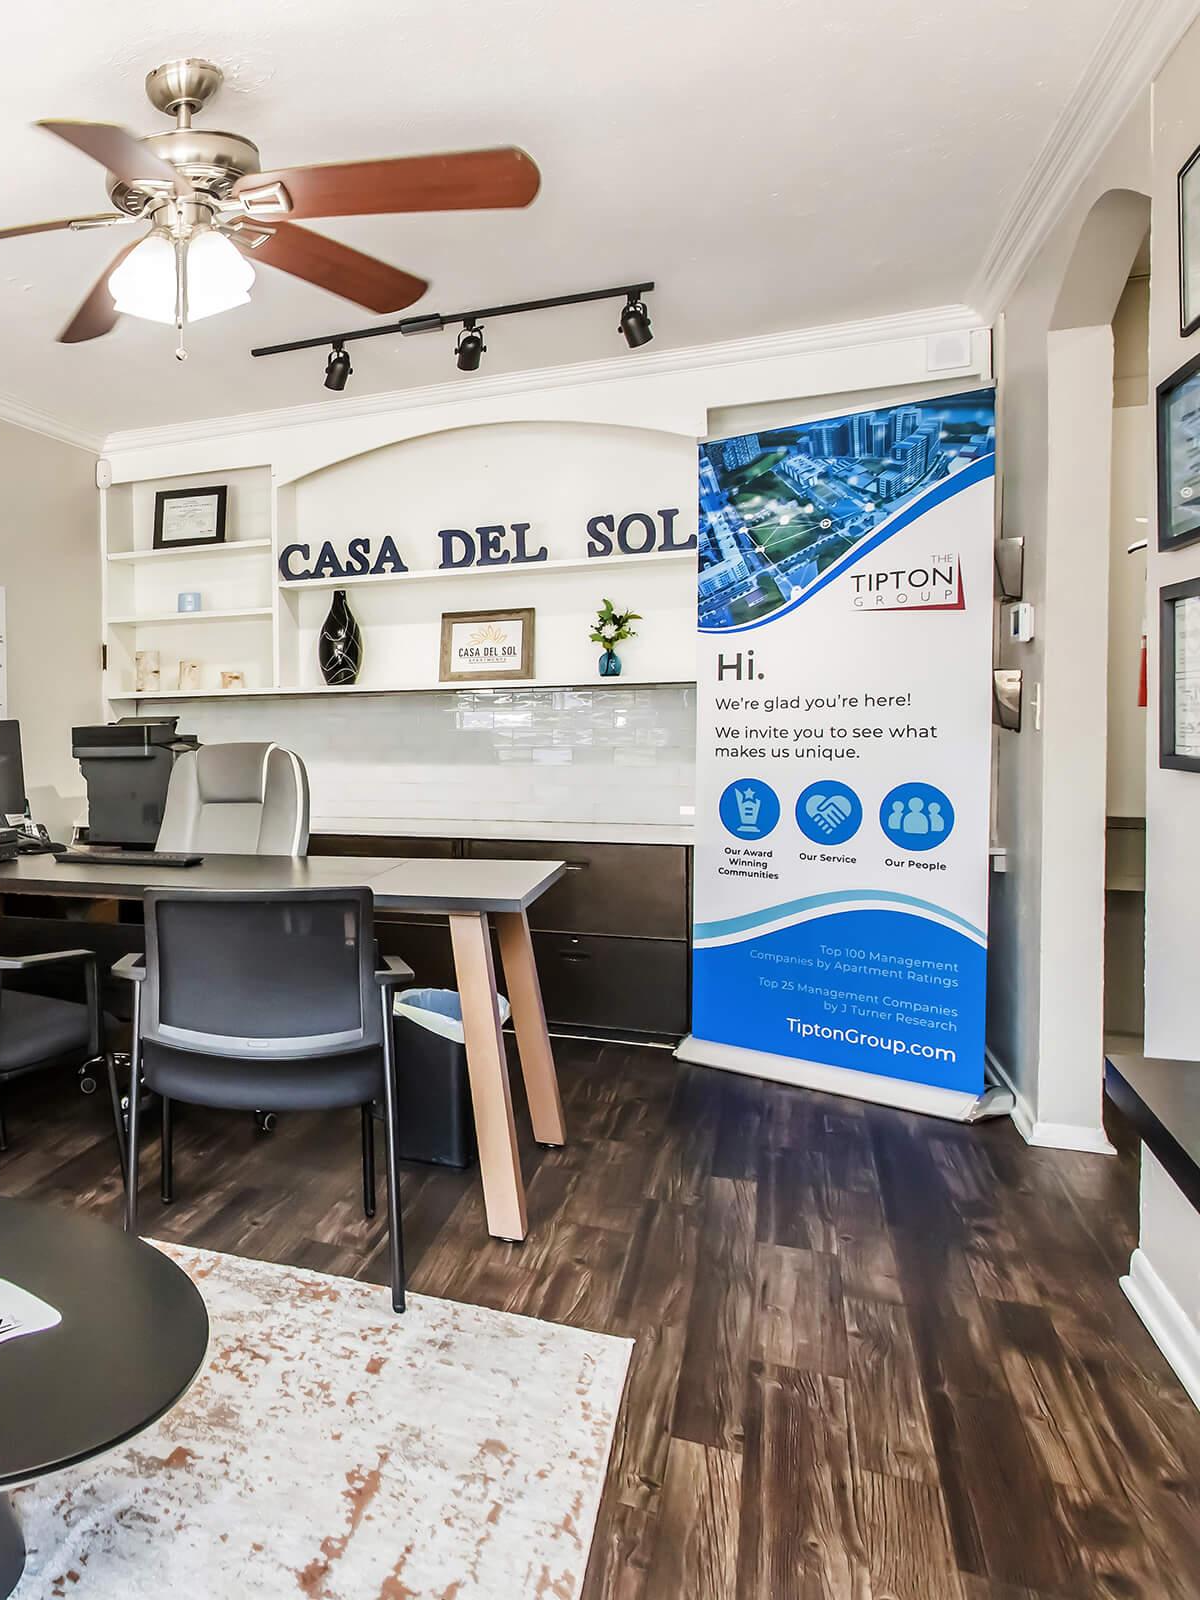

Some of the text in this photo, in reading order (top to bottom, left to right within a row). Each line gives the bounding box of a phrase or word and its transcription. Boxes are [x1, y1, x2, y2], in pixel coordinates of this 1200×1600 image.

[279, 508, 698, 581] CASA DEL SOL
[930, 553, 953, 564] THE
[850, 566, 953, 593] TIPTON
[853, 589, 953, 607] GROUP
[458, 645, 517, 658] CASA DEL SOL
[717, 649, 765, 682] Hi.
[715, 692, 912, 713] We're glad you're here!
[715, 724, 938, 742] We invite you to see what
[715, 745, 860, 761] makes us unique.
[724, 847, 773, 858] Our Award
[799, 852, 857, 864] Our Service
[728, 857, 768, 869] Winning
[884, 858, 947, 872] Our People
[718, 867, 779, 880] Communities
[820, 944, 960, 973] Top 100 Management
[749, 949, 960, 989] Companies by Apartment Ratings
[759, 976, 959, 1018] Top 25 Management Companies
[823, 1000, 957, 1032] by J Turner Research
[786, 1017, 957, 1063] TiptonGroup.com
